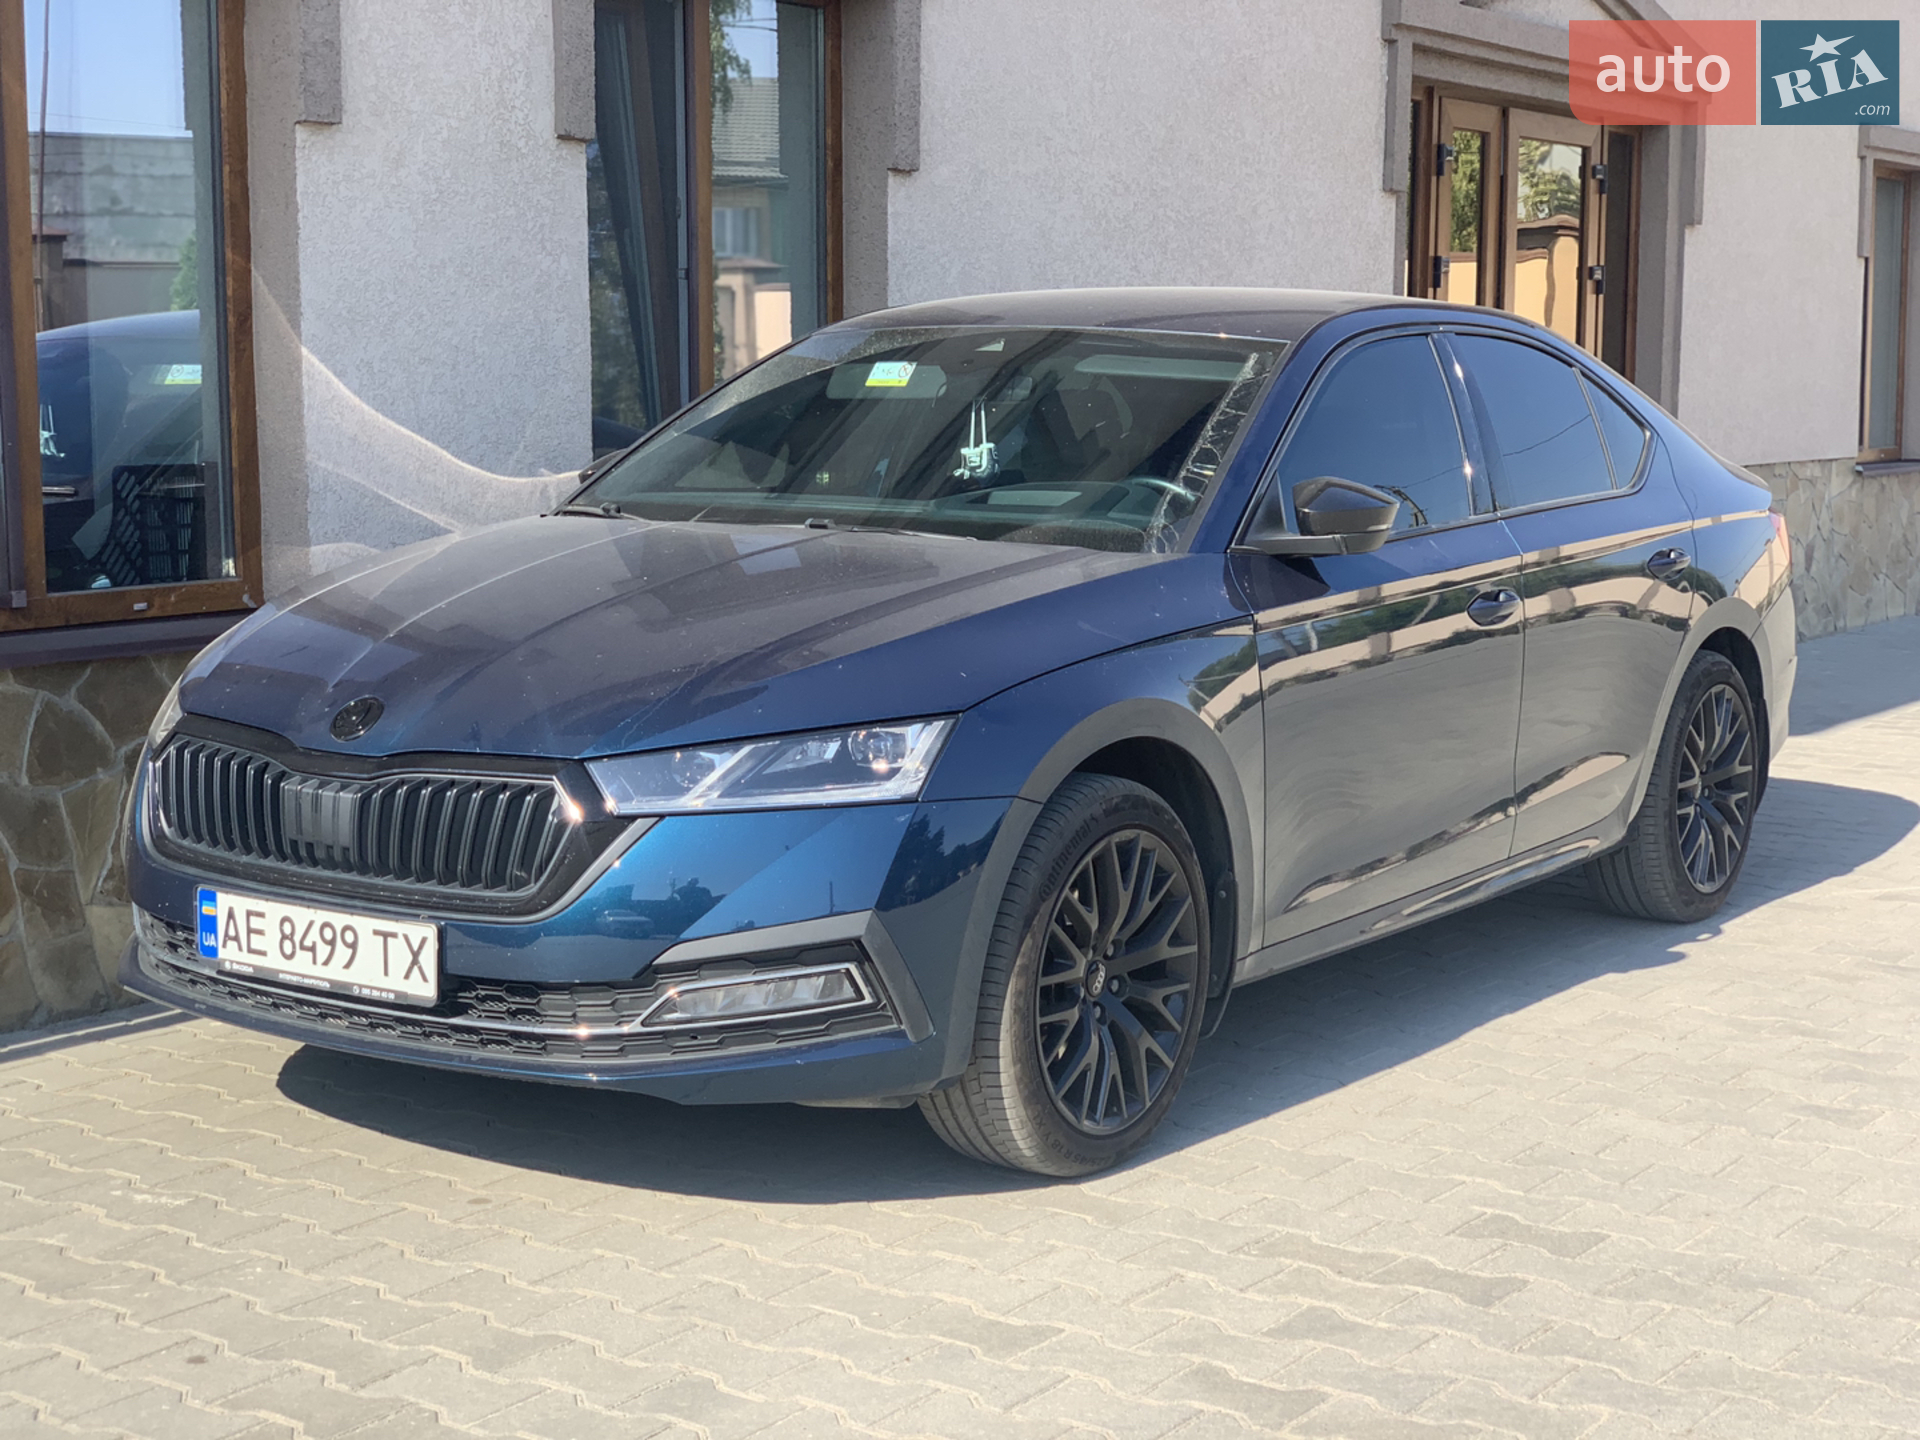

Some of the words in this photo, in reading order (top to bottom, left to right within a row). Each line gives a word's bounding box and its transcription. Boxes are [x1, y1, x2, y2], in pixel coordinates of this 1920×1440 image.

[1039, 818, 1094, 902] Continental
[202, 932, 217, 947] UA
[221, 906, 268, 958] AE
[278, 915, 359, 970] 8499
[372, 928, 430, 983] TX
